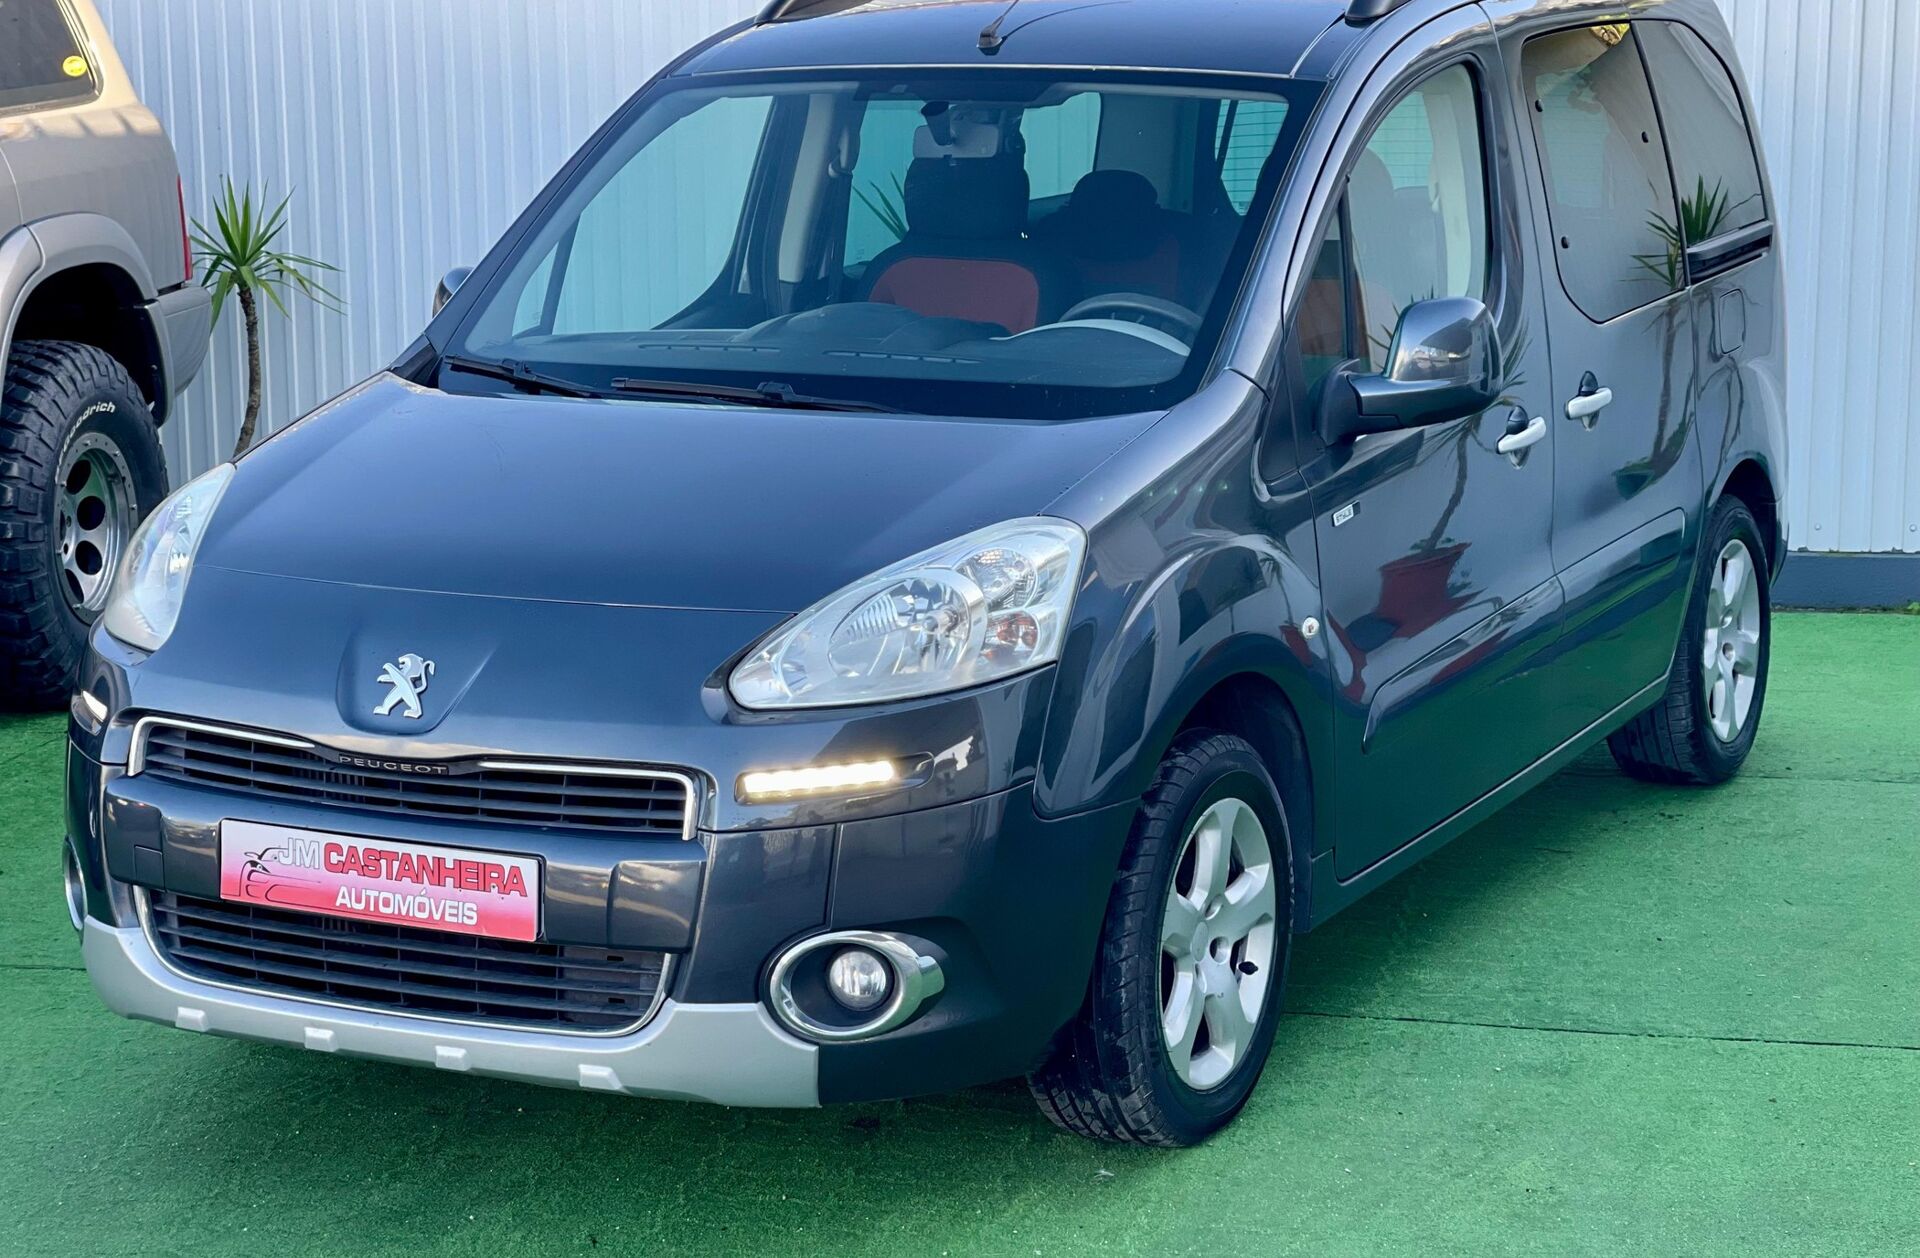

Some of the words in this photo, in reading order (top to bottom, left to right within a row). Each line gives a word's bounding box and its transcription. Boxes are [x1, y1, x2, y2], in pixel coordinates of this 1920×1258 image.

[339, 755, 447, 774] PEUGEOT
[277, 837, 320, 869] JM
[323, 842, 528, 897] CASTANHEIRA
[335, 885, 479, 926] AUTOMÓVEIS
